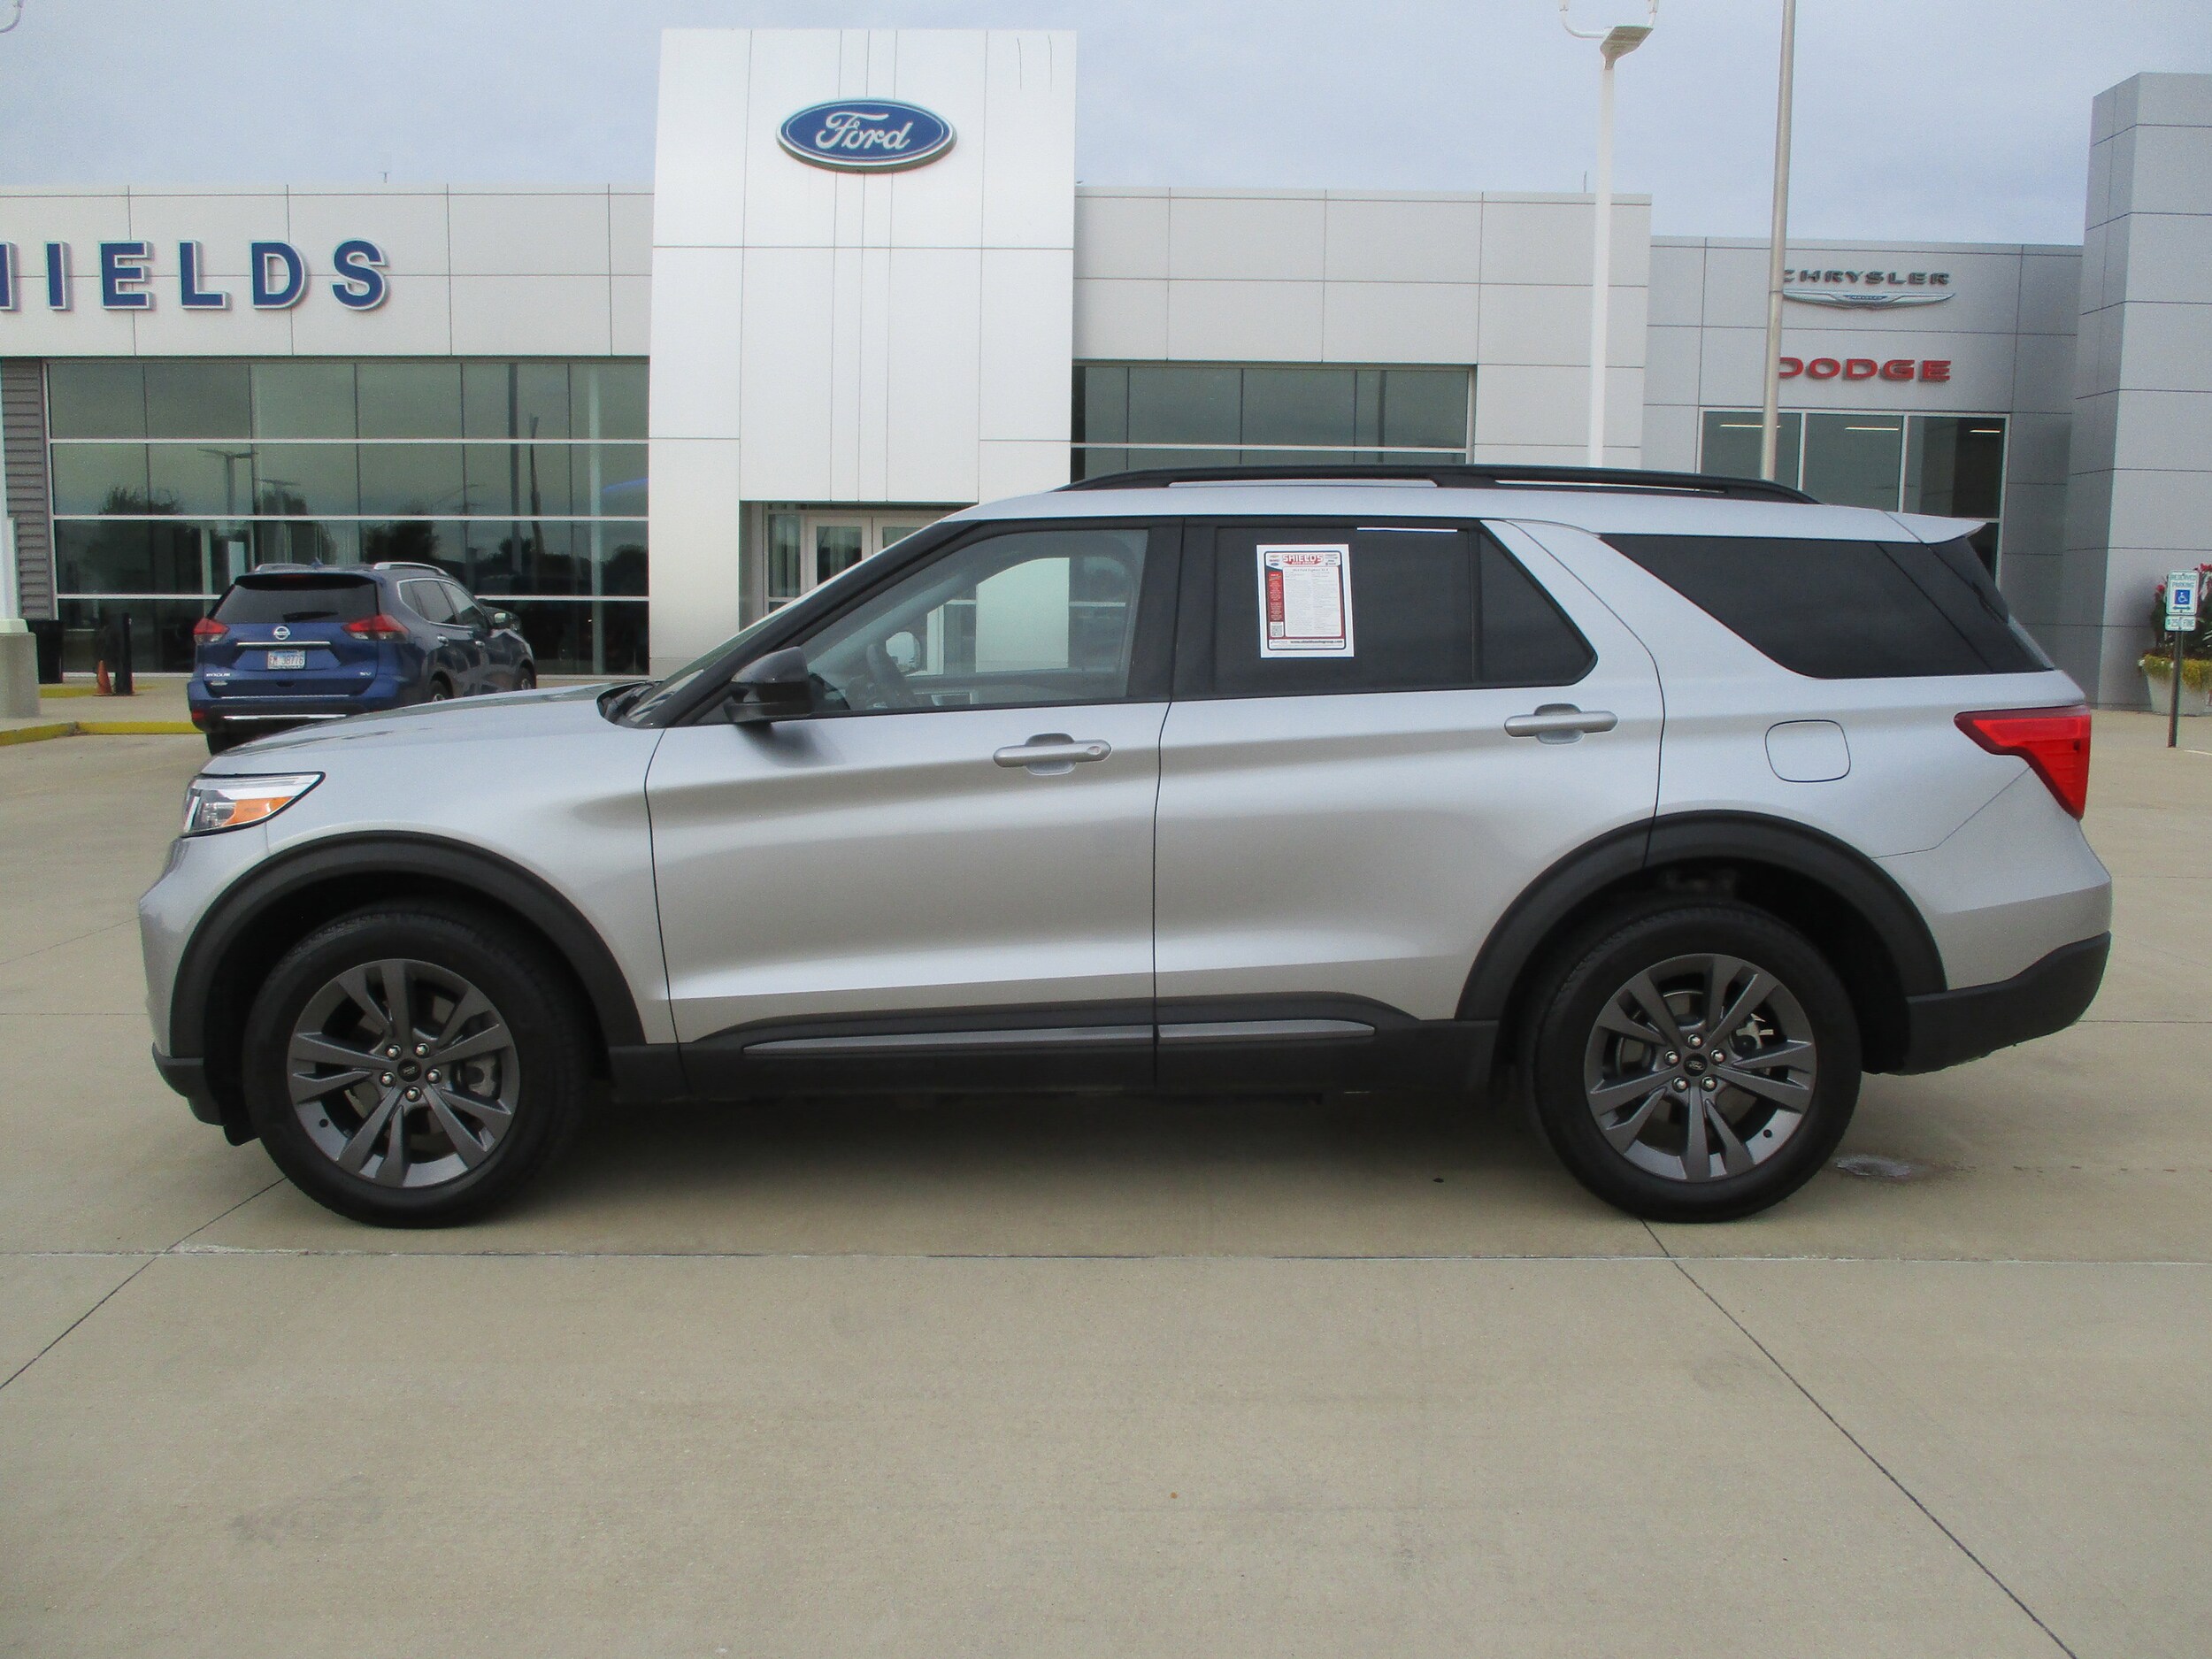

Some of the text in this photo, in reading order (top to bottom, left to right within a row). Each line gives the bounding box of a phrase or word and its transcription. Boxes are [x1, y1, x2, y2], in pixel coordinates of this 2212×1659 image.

[815, 111, 913, 150] Ford
[0, 238, 389, 311] IELDS
[1778, 357, 1952, 381] DODGE
